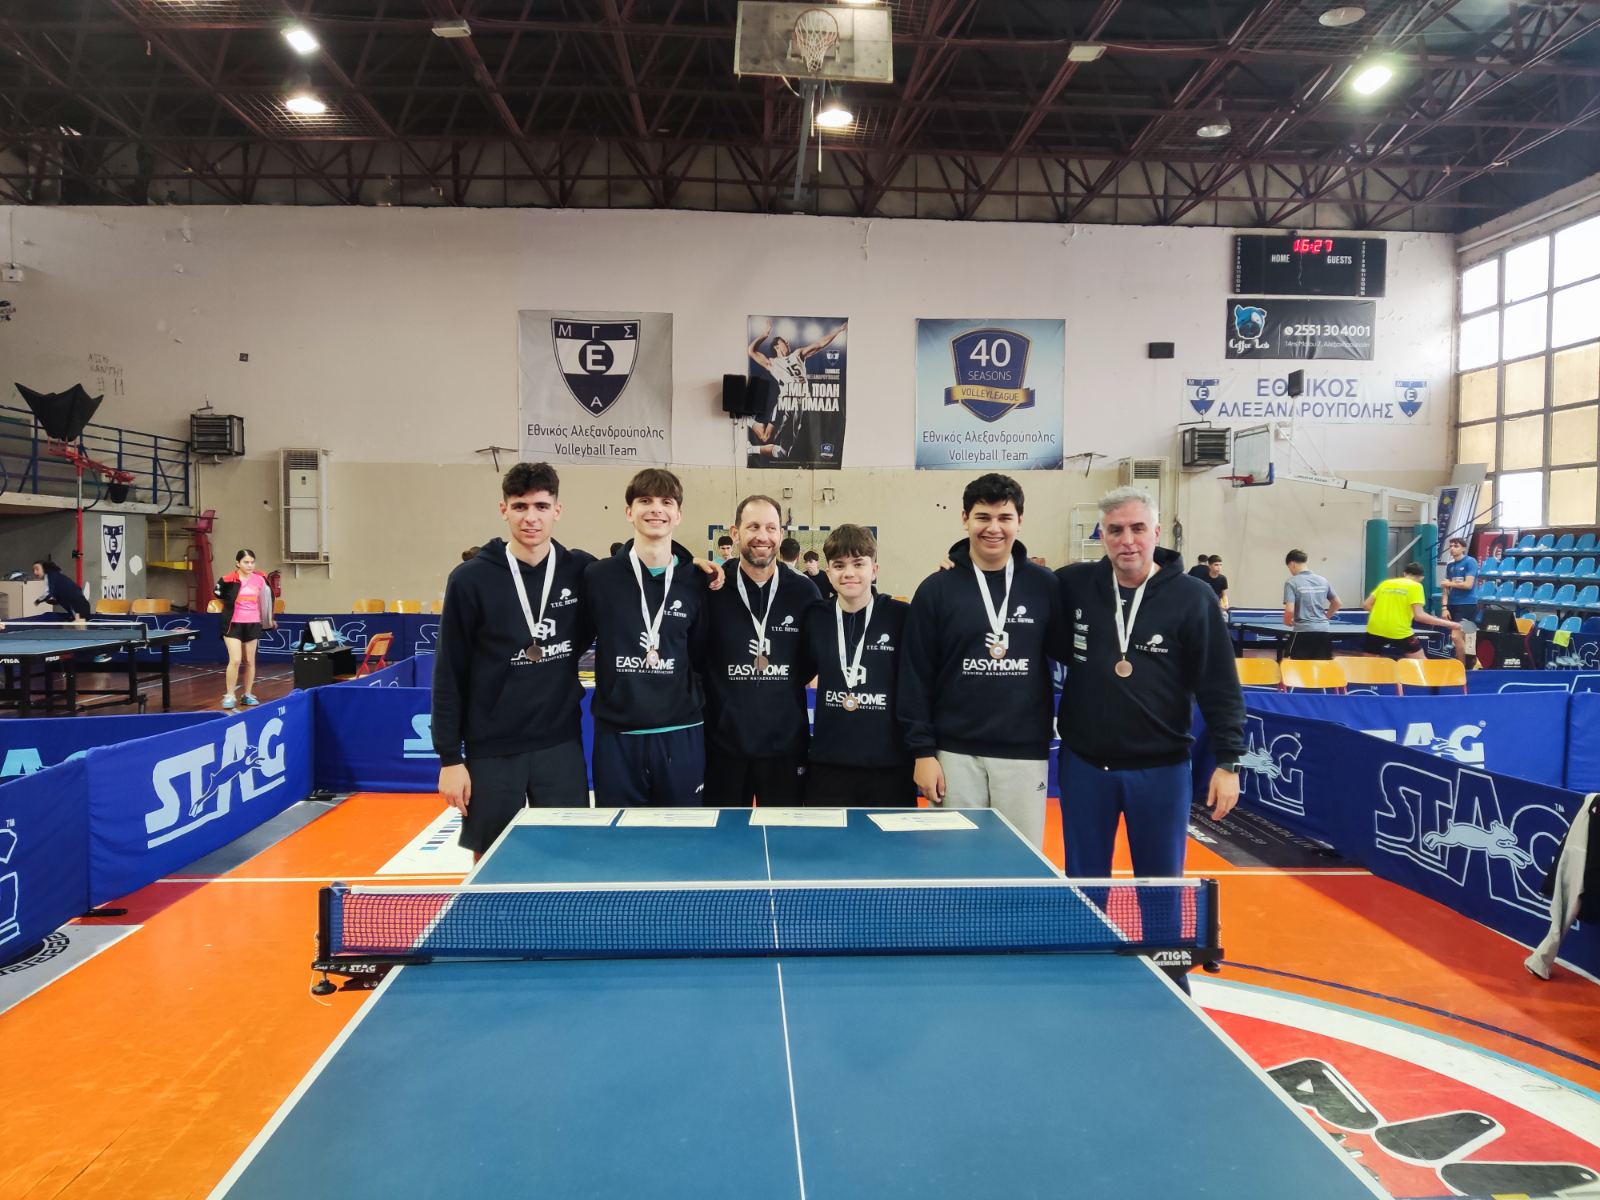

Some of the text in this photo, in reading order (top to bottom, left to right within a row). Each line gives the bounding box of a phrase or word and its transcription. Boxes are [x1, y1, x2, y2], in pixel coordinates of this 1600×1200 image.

[1294, 239, 1333, 253] 16:27
[1271, 254, 1290, 263] HOME
[1327, 255, 1352, 264] GUESTS
[970, 338, 1011, 367] 40
[786, 364, 801, 377] 15
[968, 371, 1012, 381] SEASONS
[788, 383, 840, 397] ΜΙΑ ΠΟΛΗ
[961, 388, 1020, 401] VOLLEYLEAGUE
[1257, 378, 1358, 398] ΕΘΙΚΟΣ
[778, 398, 840, 411] ΜΙΑ ΟΜΑΔΑ
[1218, 401, 1394, 419] ΑΛΕΞΑΝΔΡΟΥΠΟΛΗΣ
[527, 424, 664, 440] Εθνικός Αλεξανδρούπολης
[923, 430, 1056, 444] Εθνικός Αλεξανδρούπολης
[555, 443, 637, 457] Volleyball Team
[949, 450, 1029, 463] Volleyball Team
[962, 659, 1029, 671] EASYHOME
[144, 716, 287, 848] STAG
[1153, 950, 1192, 961] STIGA
[348, 964, 376, 973] STAG
